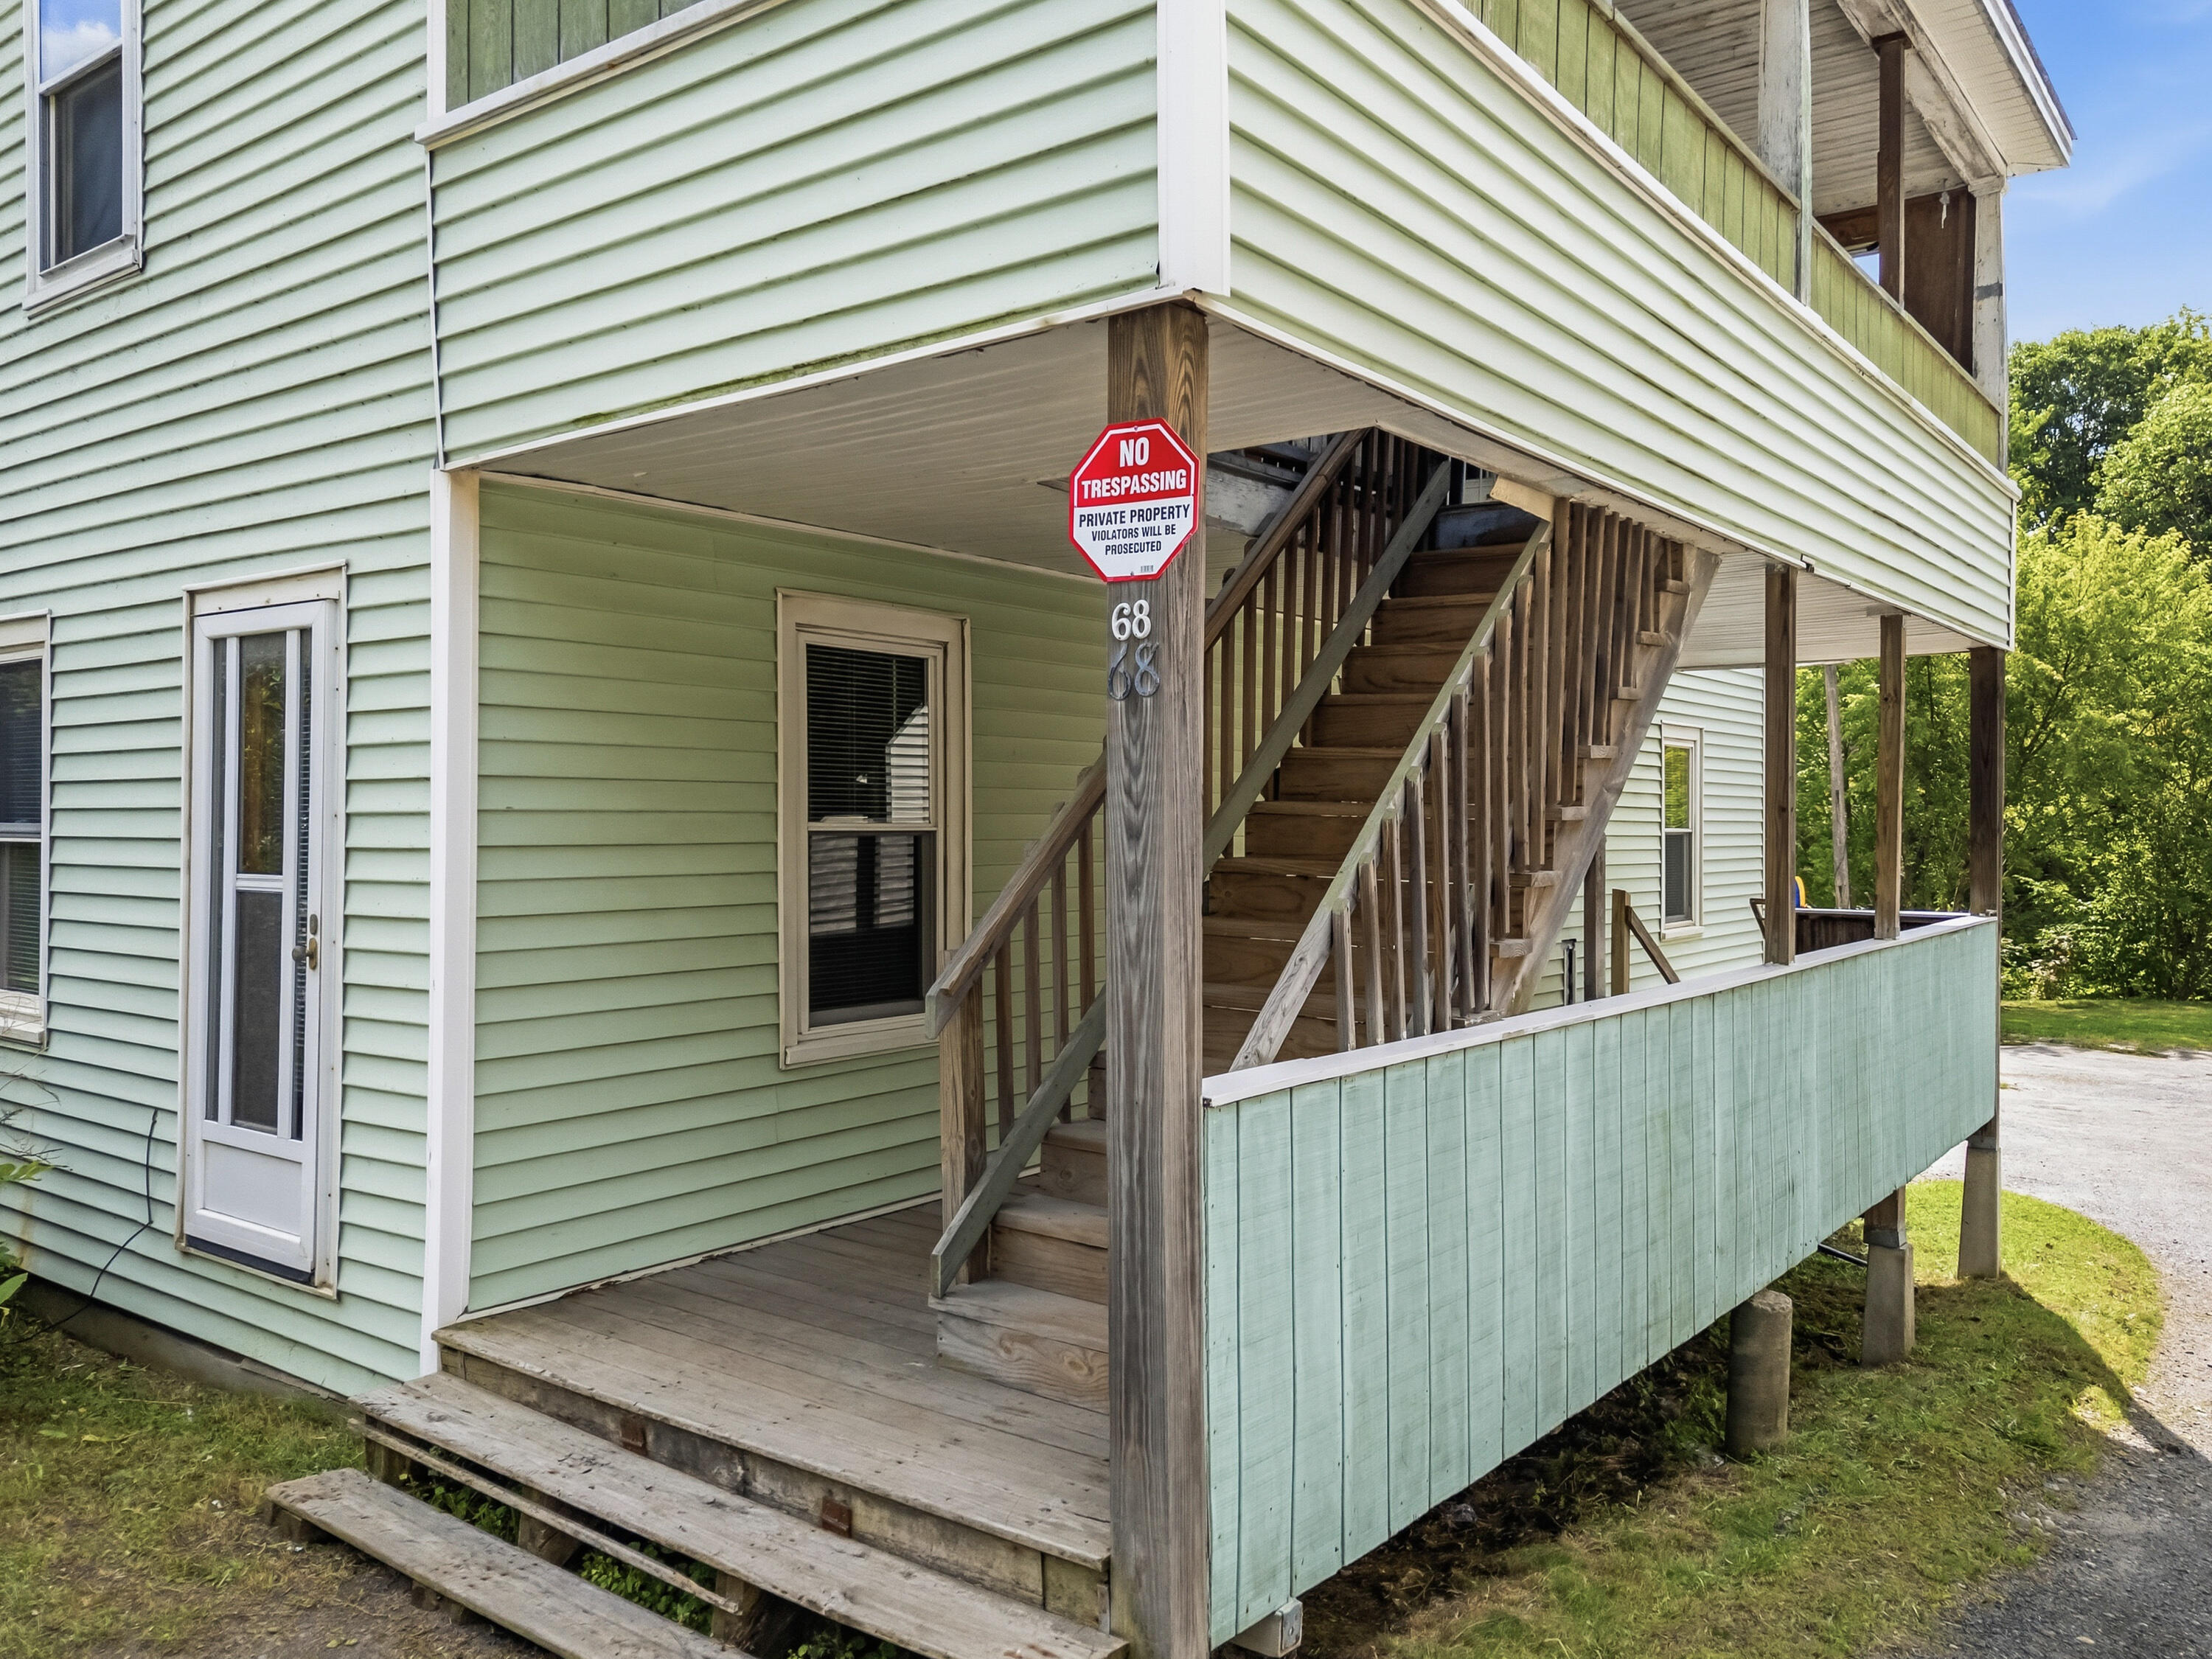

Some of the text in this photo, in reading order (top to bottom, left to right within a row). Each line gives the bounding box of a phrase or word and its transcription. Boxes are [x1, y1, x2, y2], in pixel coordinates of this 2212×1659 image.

[1119, 437, 1150, 467] NO
[1081, 469, 1186, 499] TRESPASSING
[1079, 504, 1190, 527] PRIVATE PROPERTY
[1092, 524, 1176, 541] VIOLATORS WILL BE
[1105, 540, 1162, 555] PROSECUTED
[1111, 599, 1152, 641] 68
[1108, 641, 1160, 700] 68
